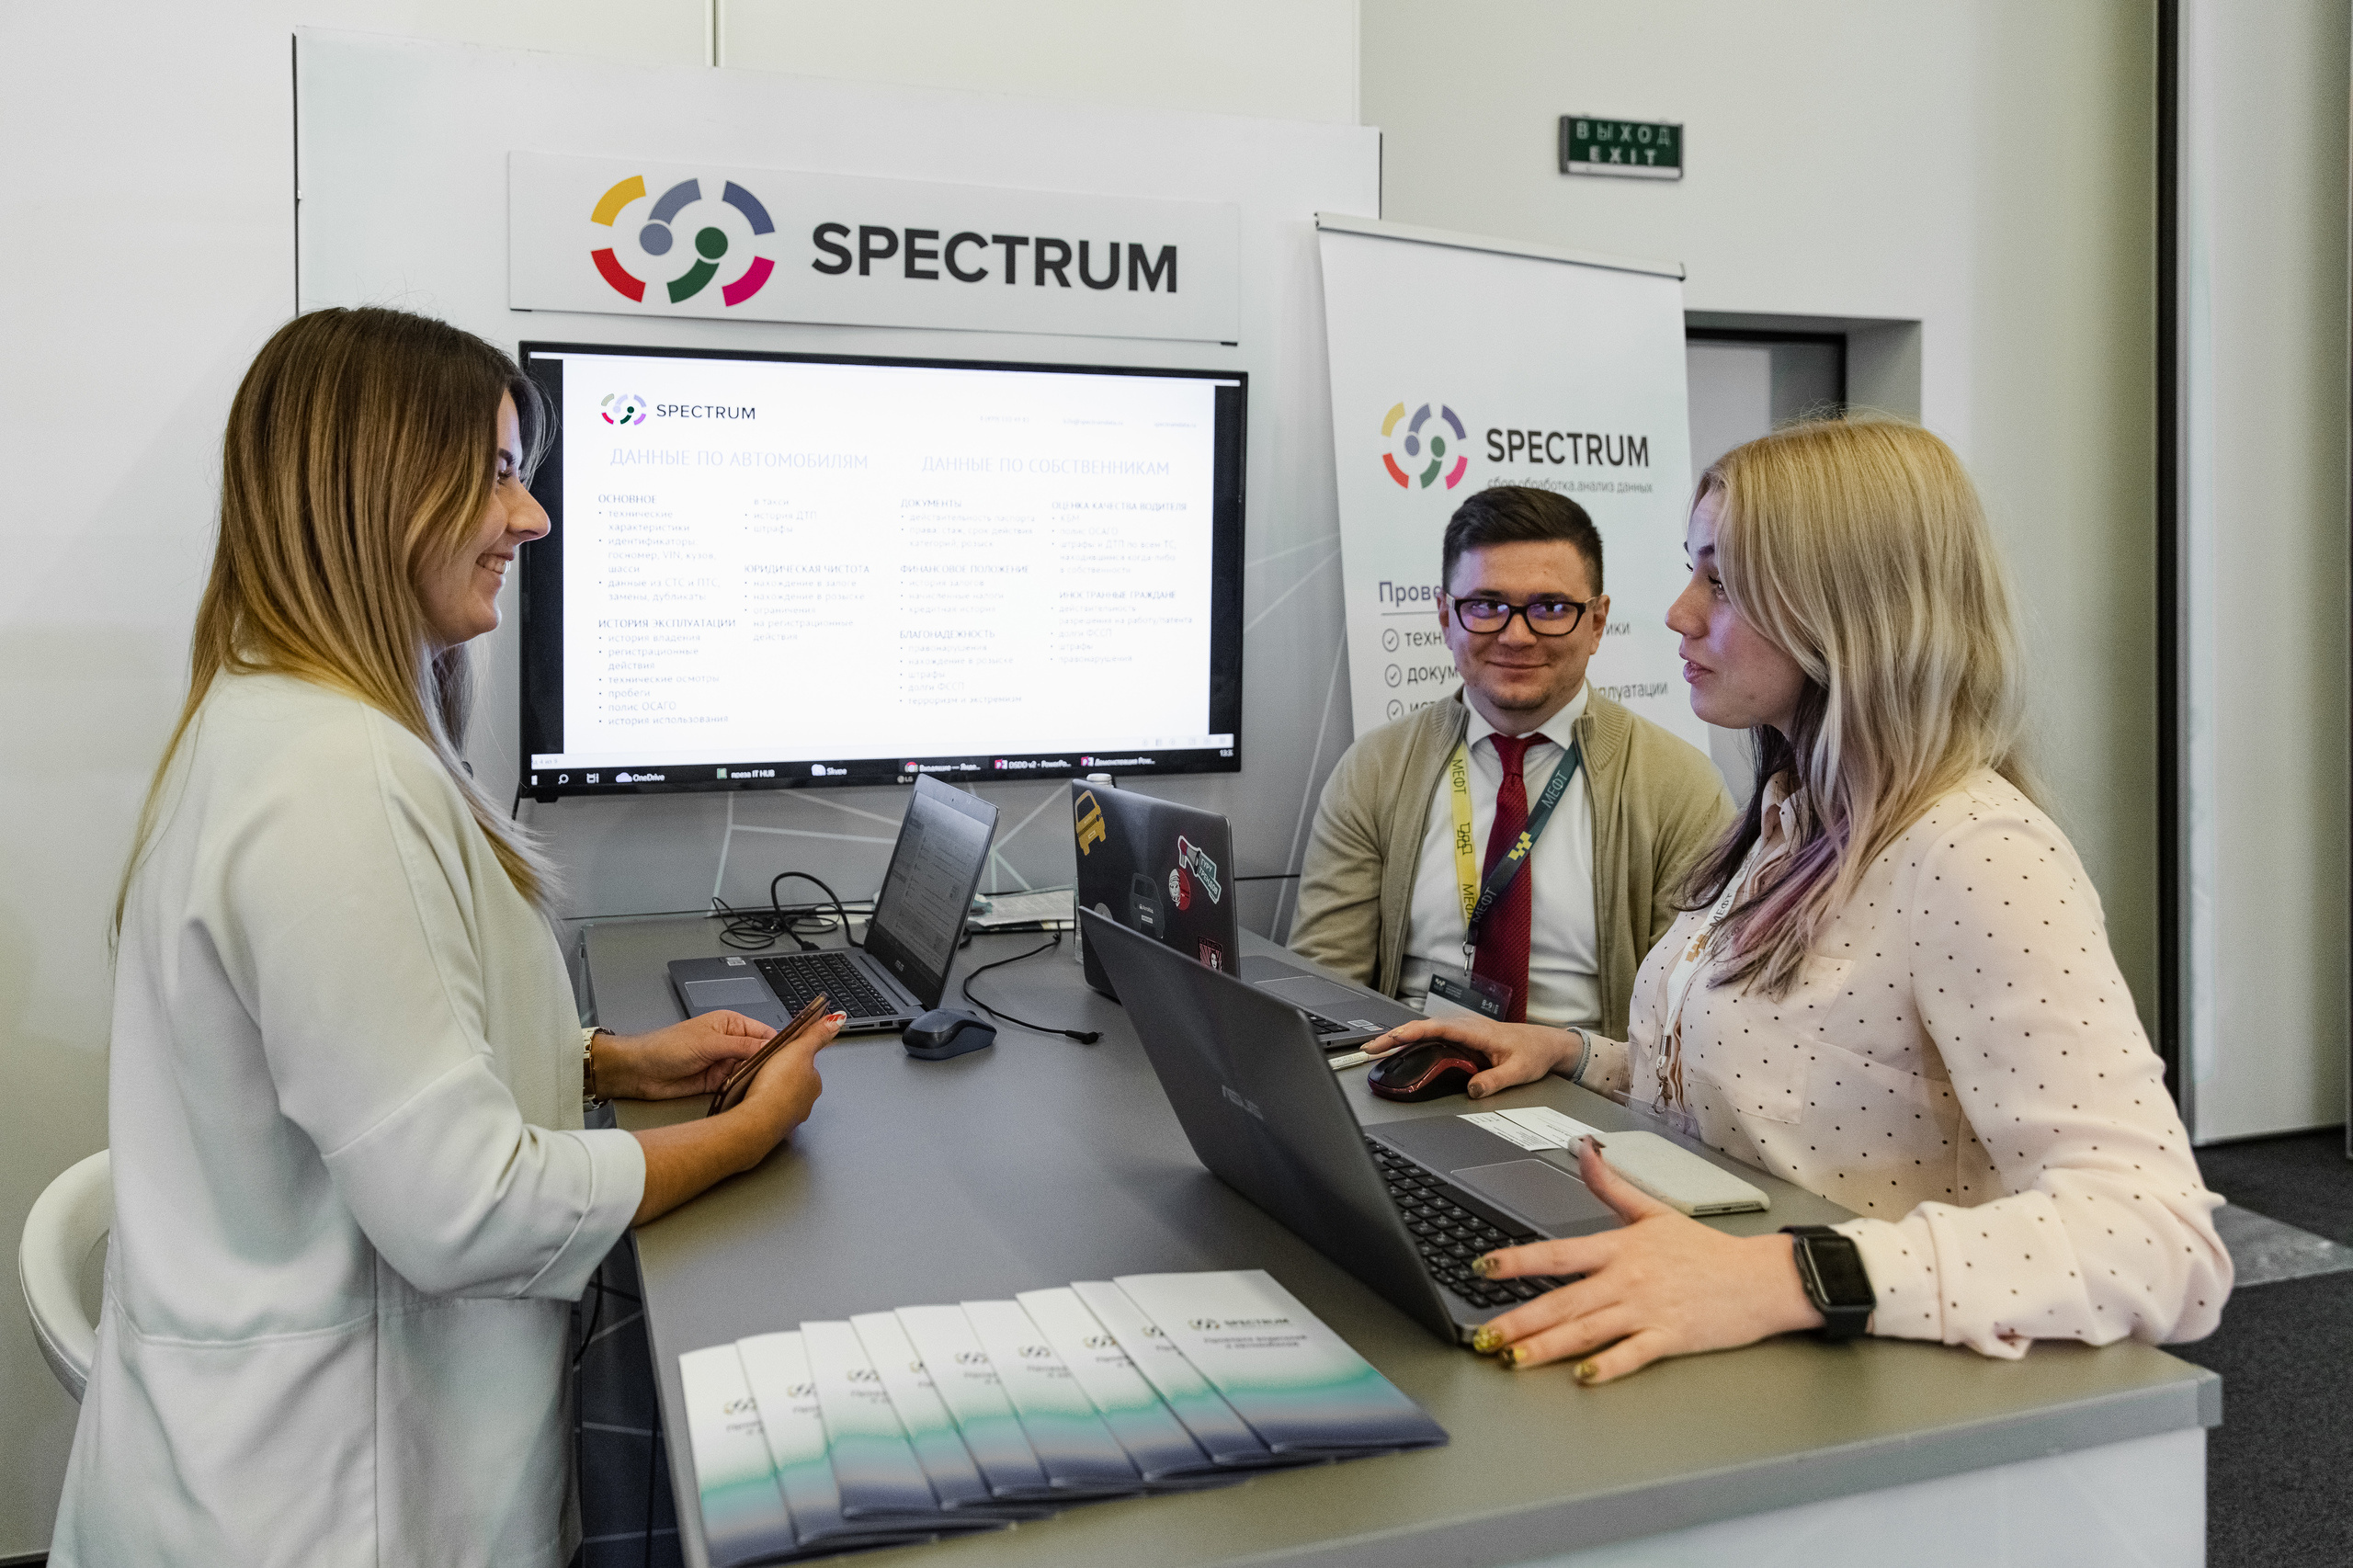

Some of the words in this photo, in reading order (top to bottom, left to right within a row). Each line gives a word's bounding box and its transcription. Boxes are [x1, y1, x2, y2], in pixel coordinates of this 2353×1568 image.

[1575, 120, 1672, 147] ВЫХОД
[1588, 144, 1657, 165] EXIT
[811, 222, 1178, 293] SPECTRUM
[656, 403, 756, 420] SPECTRUM
[1486, 428, 1649, 467] SPECTRUM
[609, 448, 690, 467] ДАННЫЕ
[697, 449, 723, 467] ПО
[729, 451, 868, 470] АВТОМОБИЛЯМ
[921, 455, 993, 472] ДАННЫЕ
[999, 457, 1023, 472] ПО
[1029, 459, 1170, 475] СОБСТВЕННИКАМ
[1616, 482, 1654, 494] данных
[597, 494, 655, 505] ОСНОВНОЕ
[900, 499, 961, 508] ДОКУМЕНТЫ
[1051, 502, 1089, 510] ОЦЕНКА
[1092, 502, 1138, 510] КАЧЕСТВА
[1139, 502, 1188, 512] ВОДИТЕЛЯ
[608, 510, 673, 518] технические
[608, 524, 690, 533] характеристики
[608, 565, 641, 574] шасси
[744, 564, 822, 574] ЮРИДИЧЕСКАЯ
[824, 564, 870, 574] ЧИСТОТА
[900, 565, 966, 574] ФИНАНСОВОЕ
[970, 565, 1029, 574] ПОЛОЖЕНИЕ
[608, 580, 647, 588] данные
[1059, 590, 1126, 599] ИНОСТРАННЫЕ
[1130, 590, 1176, 600] ГРАЖДАНЕ
[1379, 581, 1443, 608] Прове
[597, 619, 649, 629] ИСТОРИЯ
[654, 619, 736, 628] ЭКСПЛУАТАЦИИ
[608, 635, 650, 643] история
[899, 630, 995, 640] БЛАГОНАДЕЖНОСТЬ
[1404, 631, 1444, 646] техн
[1605, 622, 1630, 636] ики
[608, 648, 699, 658] регистрационные
[607, 661, 655, 672] действия
[1407, 665, 1460, 686] докум
[608, 687, 651, 699] пробеги
[1598, 682, 1668, 701] плуатации
[608, 703, 639, 712] полис
[642, 700, 676, 711] ОСАГО
[608, 717, 650, 727] история
[631, 773, 665, 782] OneDrive
[1451, 758, 1467, 794] МЕФТ
[1540, 769, 1568, 809] МЕФТ
[1472, 886, 1498, 923] МЕФТ
[1710, 893, 1733, 927] МЕФТ
